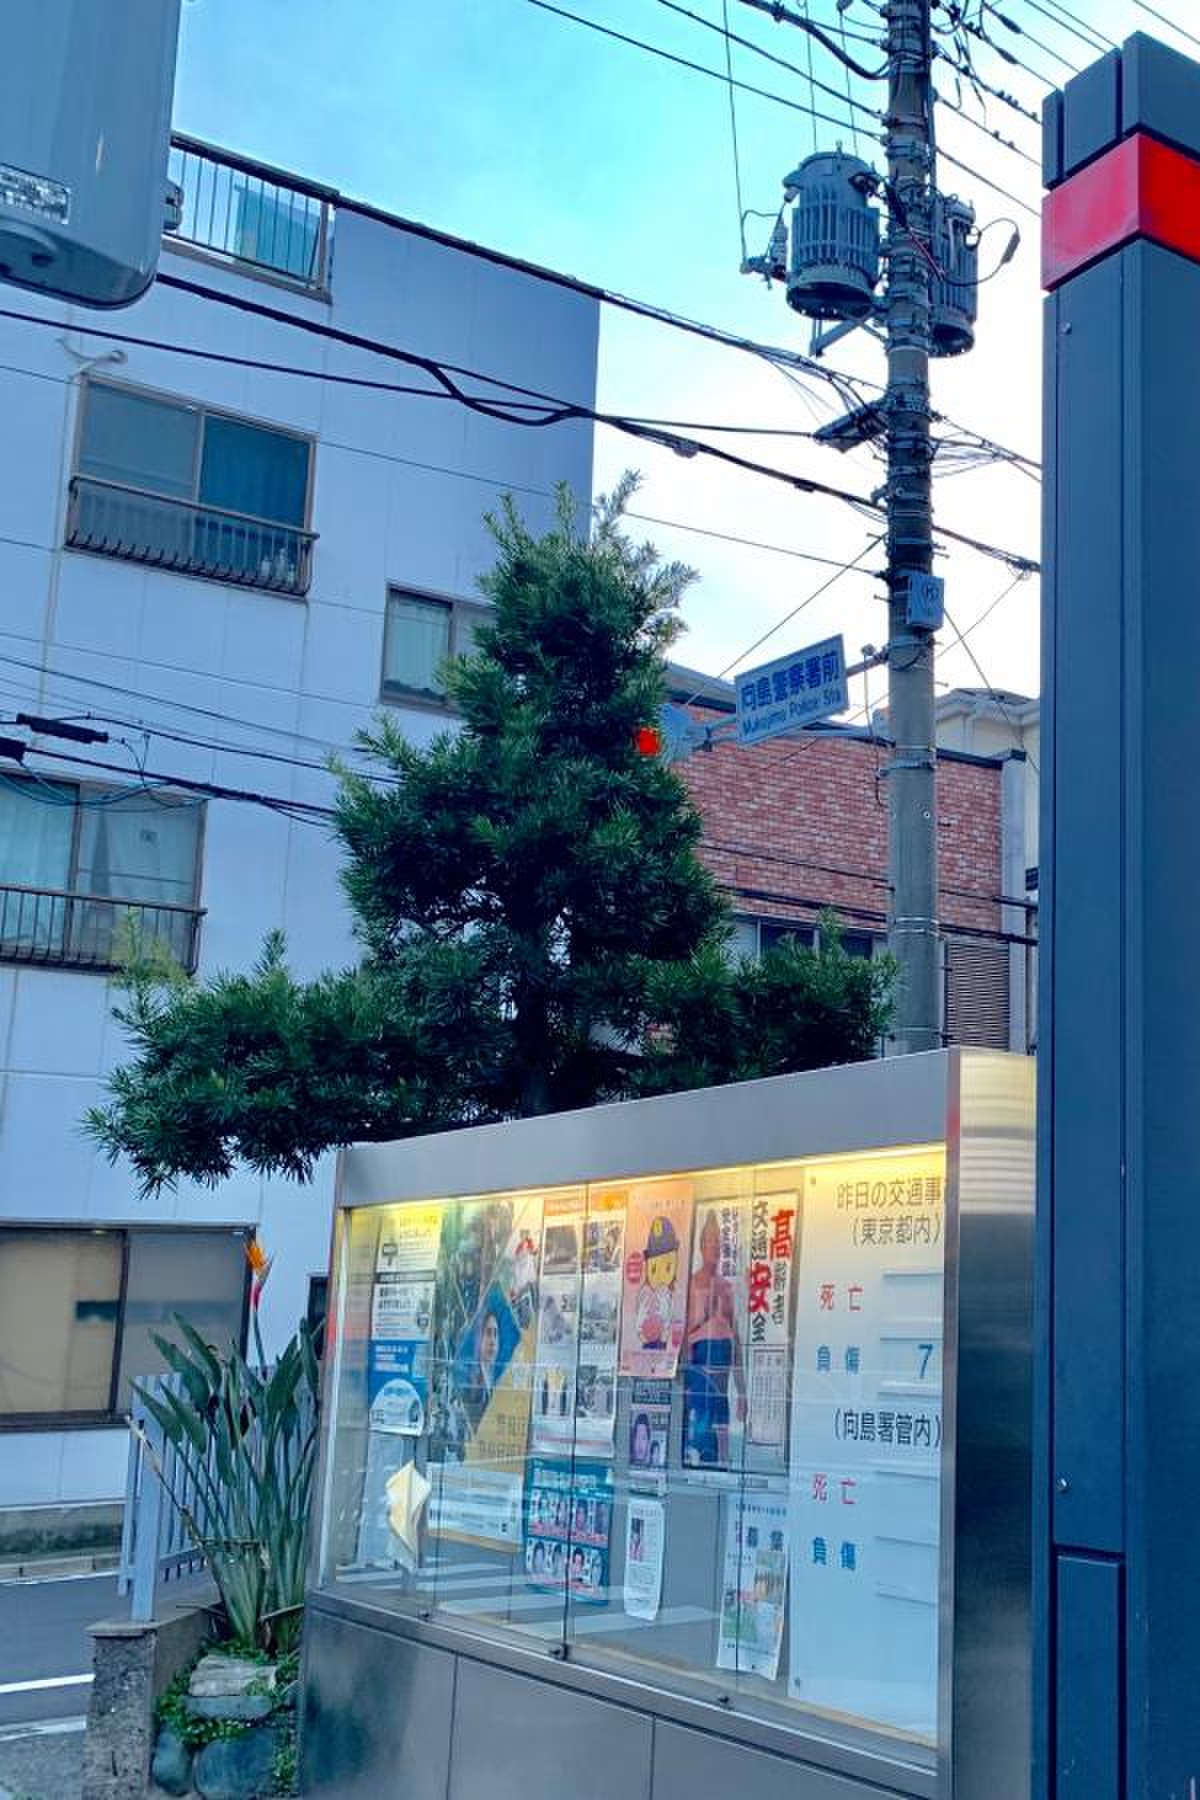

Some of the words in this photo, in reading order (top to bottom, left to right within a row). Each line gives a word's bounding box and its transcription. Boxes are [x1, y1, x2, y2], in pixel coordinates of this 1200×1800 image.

[740, 652, 840, 711] 向島警察署前
[836, 1177, 941, 1212] 昨日の交通事
[852, 1214, 941, 1246] (東京都内)
[820, 1283, 863, 1311] 死亡
[917, 1343, 934, 1380] 7
[834, 1407, 942, 1449] (向島署管内)
